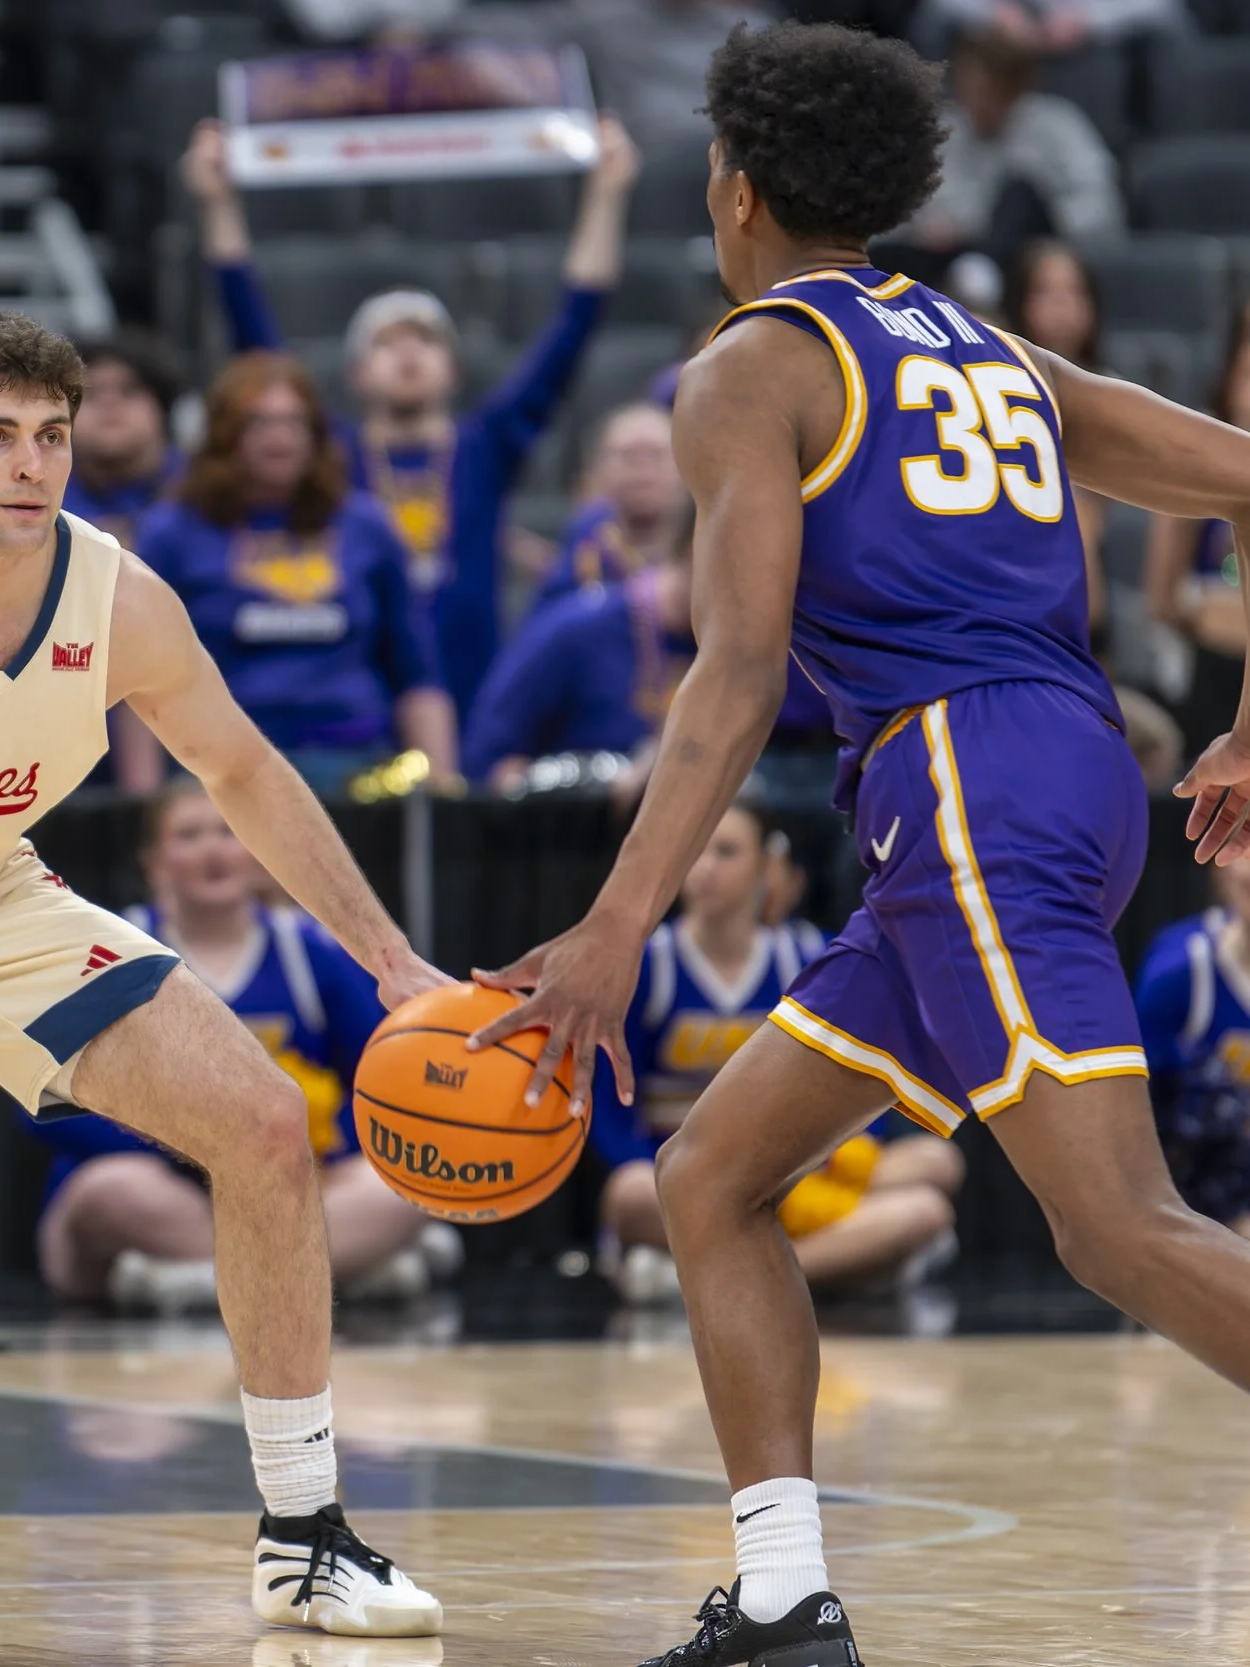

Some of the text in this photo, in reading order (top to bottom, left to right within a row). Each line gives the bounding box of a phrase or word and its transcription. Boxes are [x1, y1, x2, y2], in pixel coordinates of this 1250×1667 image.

[896, 354, 1064, 523] 35
[52, 641, 94, 667] VALLEY
[369, 1115, 516, 1185] Wilson
